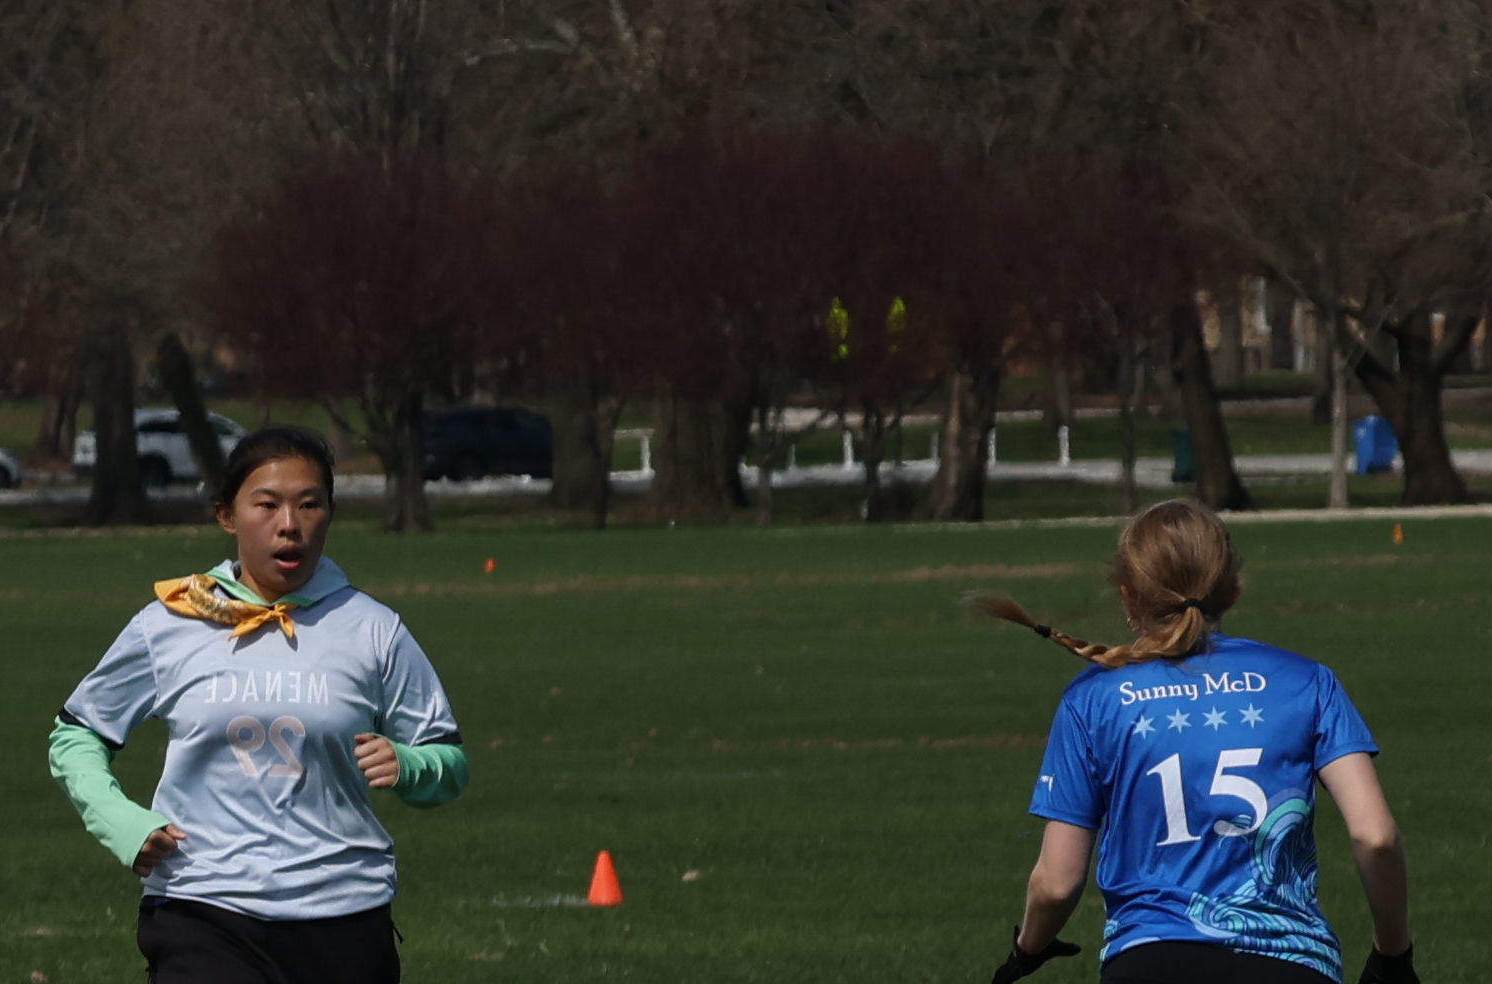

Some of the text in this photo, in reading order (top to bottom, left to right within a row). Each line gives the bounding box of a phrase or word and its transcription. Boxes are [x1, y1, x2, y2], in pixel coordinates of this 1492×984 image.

[1119, 671, 1267, 706] Sunny McD
[1146, 747, 1269, 847] 15
